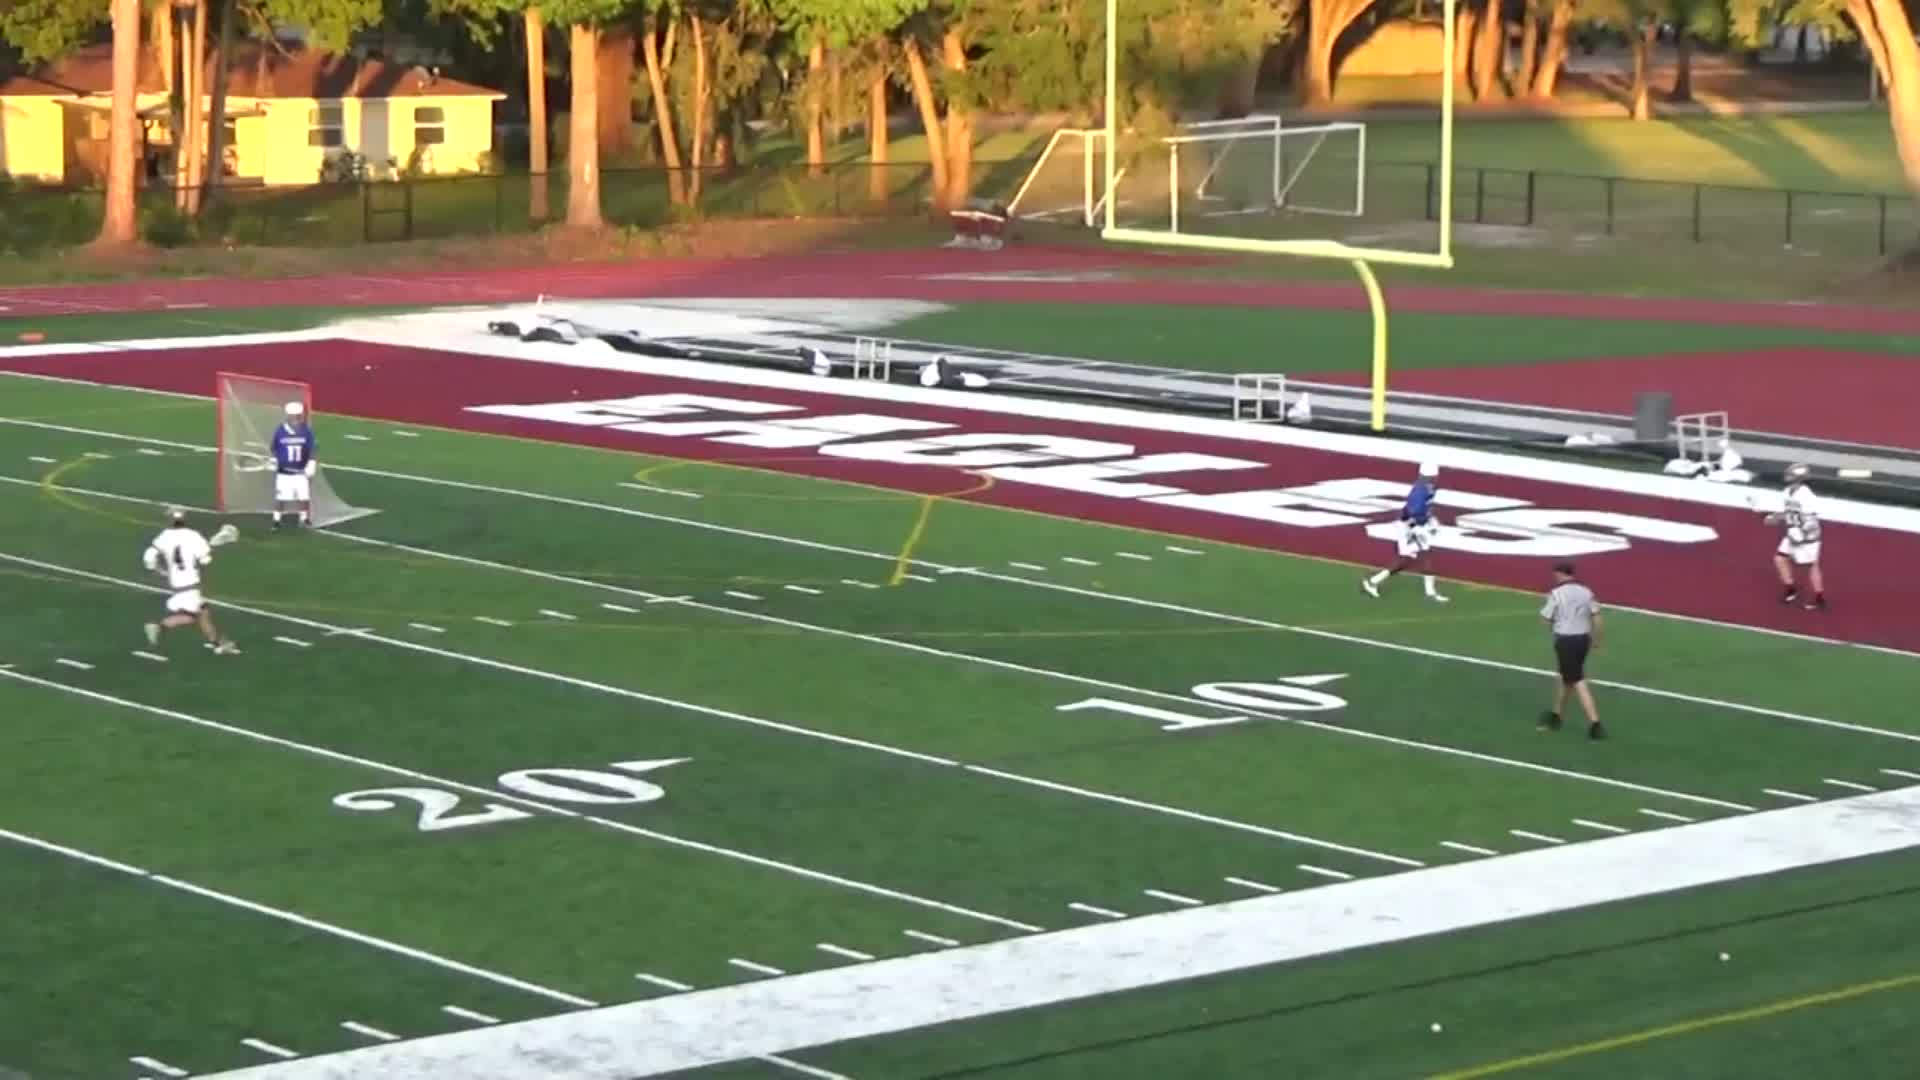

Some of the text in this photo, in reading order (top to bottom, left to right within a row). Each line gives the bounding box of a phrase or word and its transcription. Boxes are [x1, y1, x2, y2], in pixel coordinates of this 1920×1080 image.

[462, 393, 1718, 556] EAGLES
[1056, 682, 1348, 731] 10
[332, 768, 665, 831] 20
